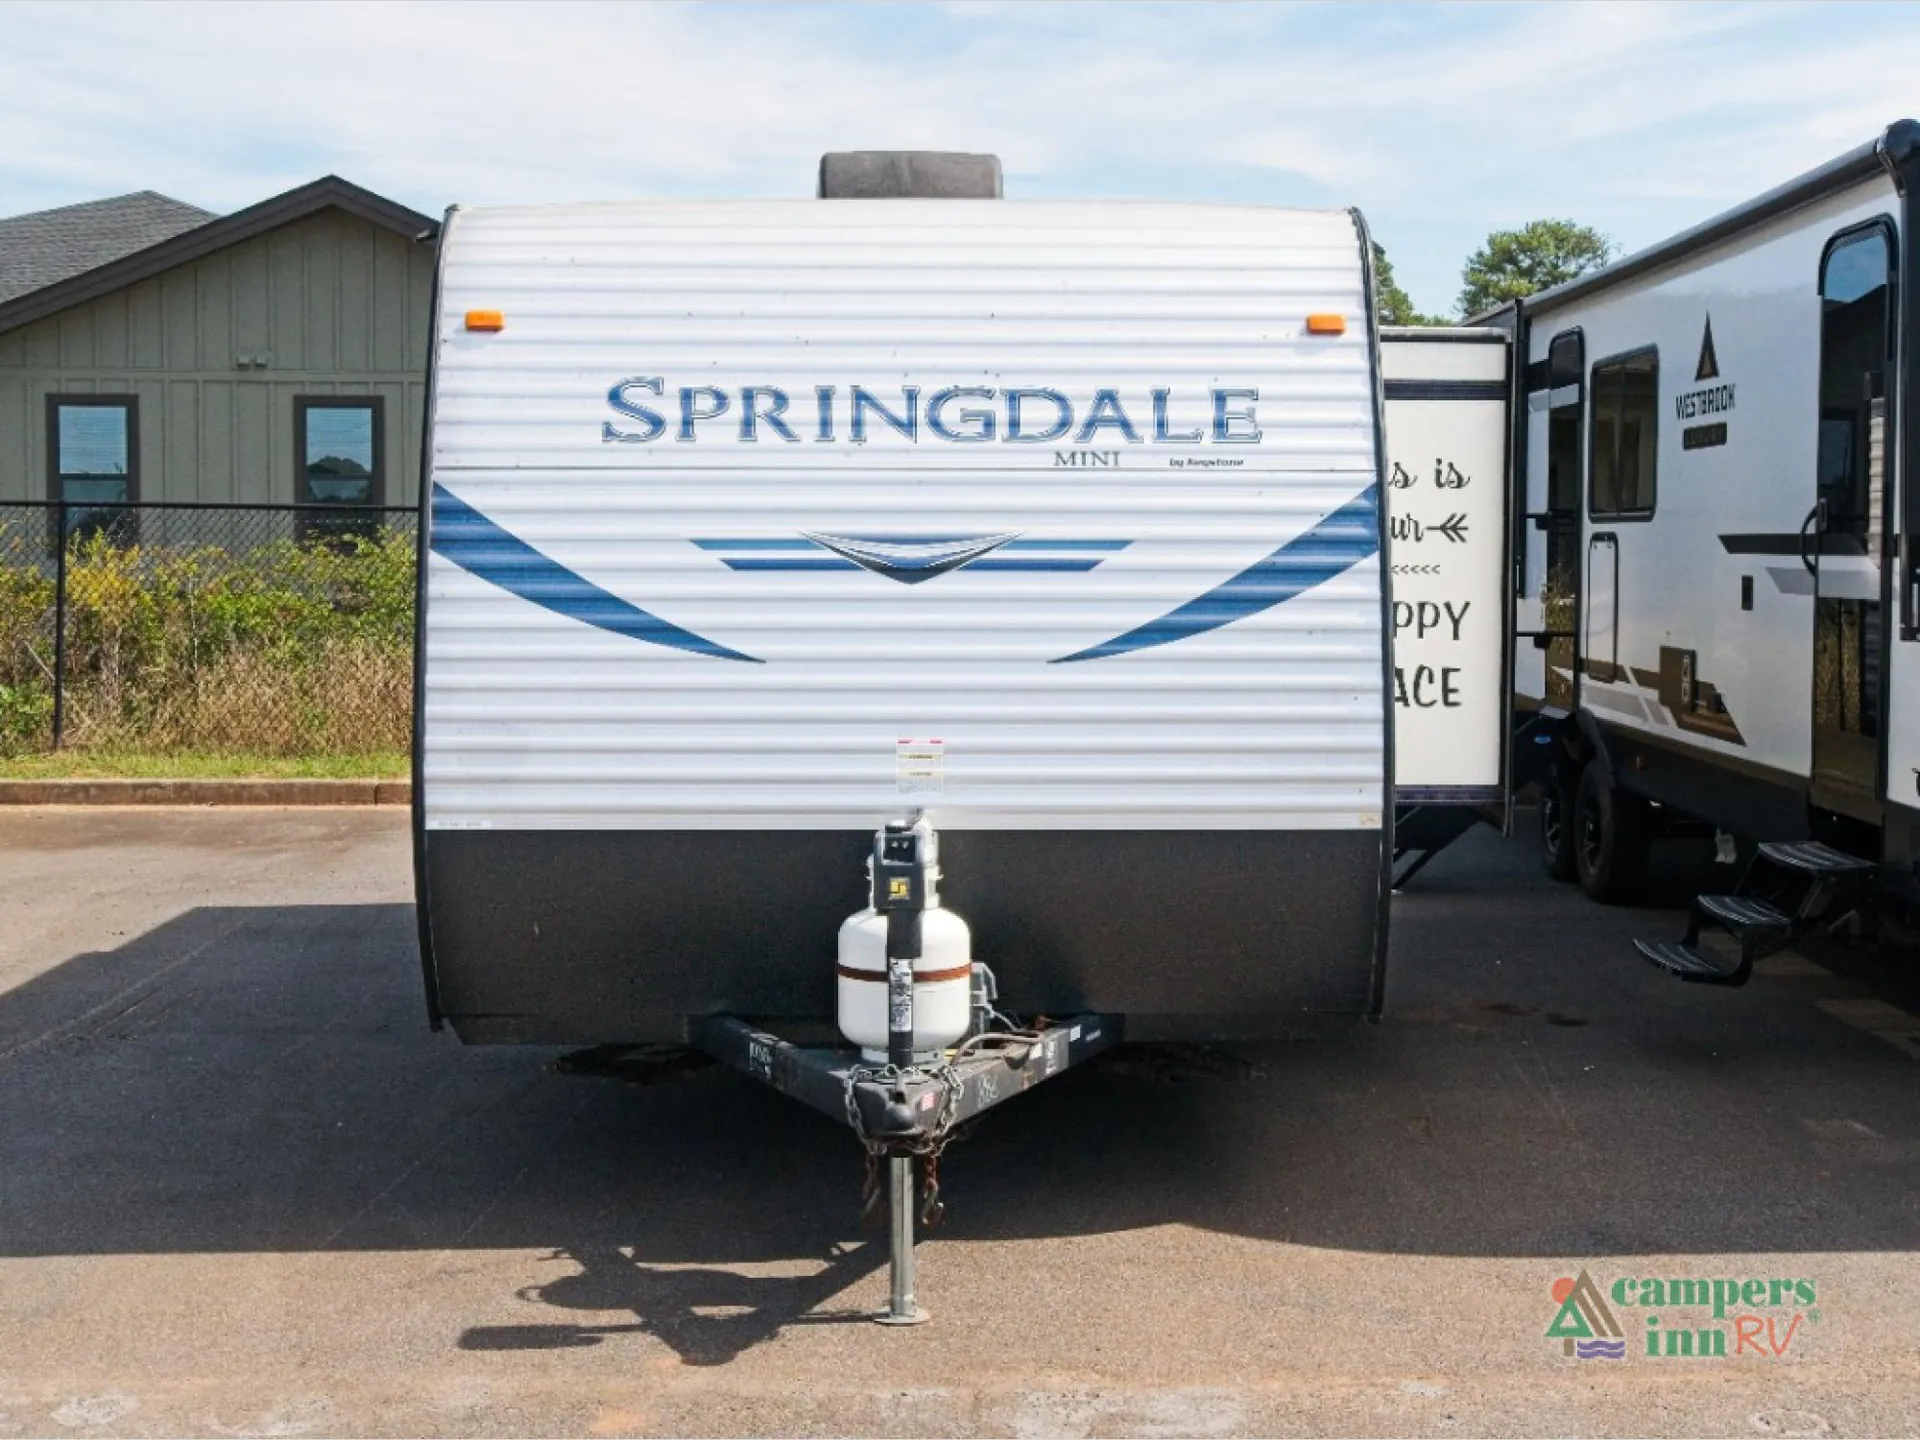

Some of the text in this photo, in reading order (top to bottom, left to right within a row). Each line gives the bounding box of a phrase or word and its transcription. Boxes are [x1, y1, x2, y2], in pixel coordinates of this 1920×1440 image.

[601, 375, 1263, 443] SPRINGDALE
[1675, 382, 1736, 420] WESTBROOK
[1054, 450, 1120, 468] MINI
[1169, 458, 1184, 467] by
[1434, 458, 1471, 489] is
